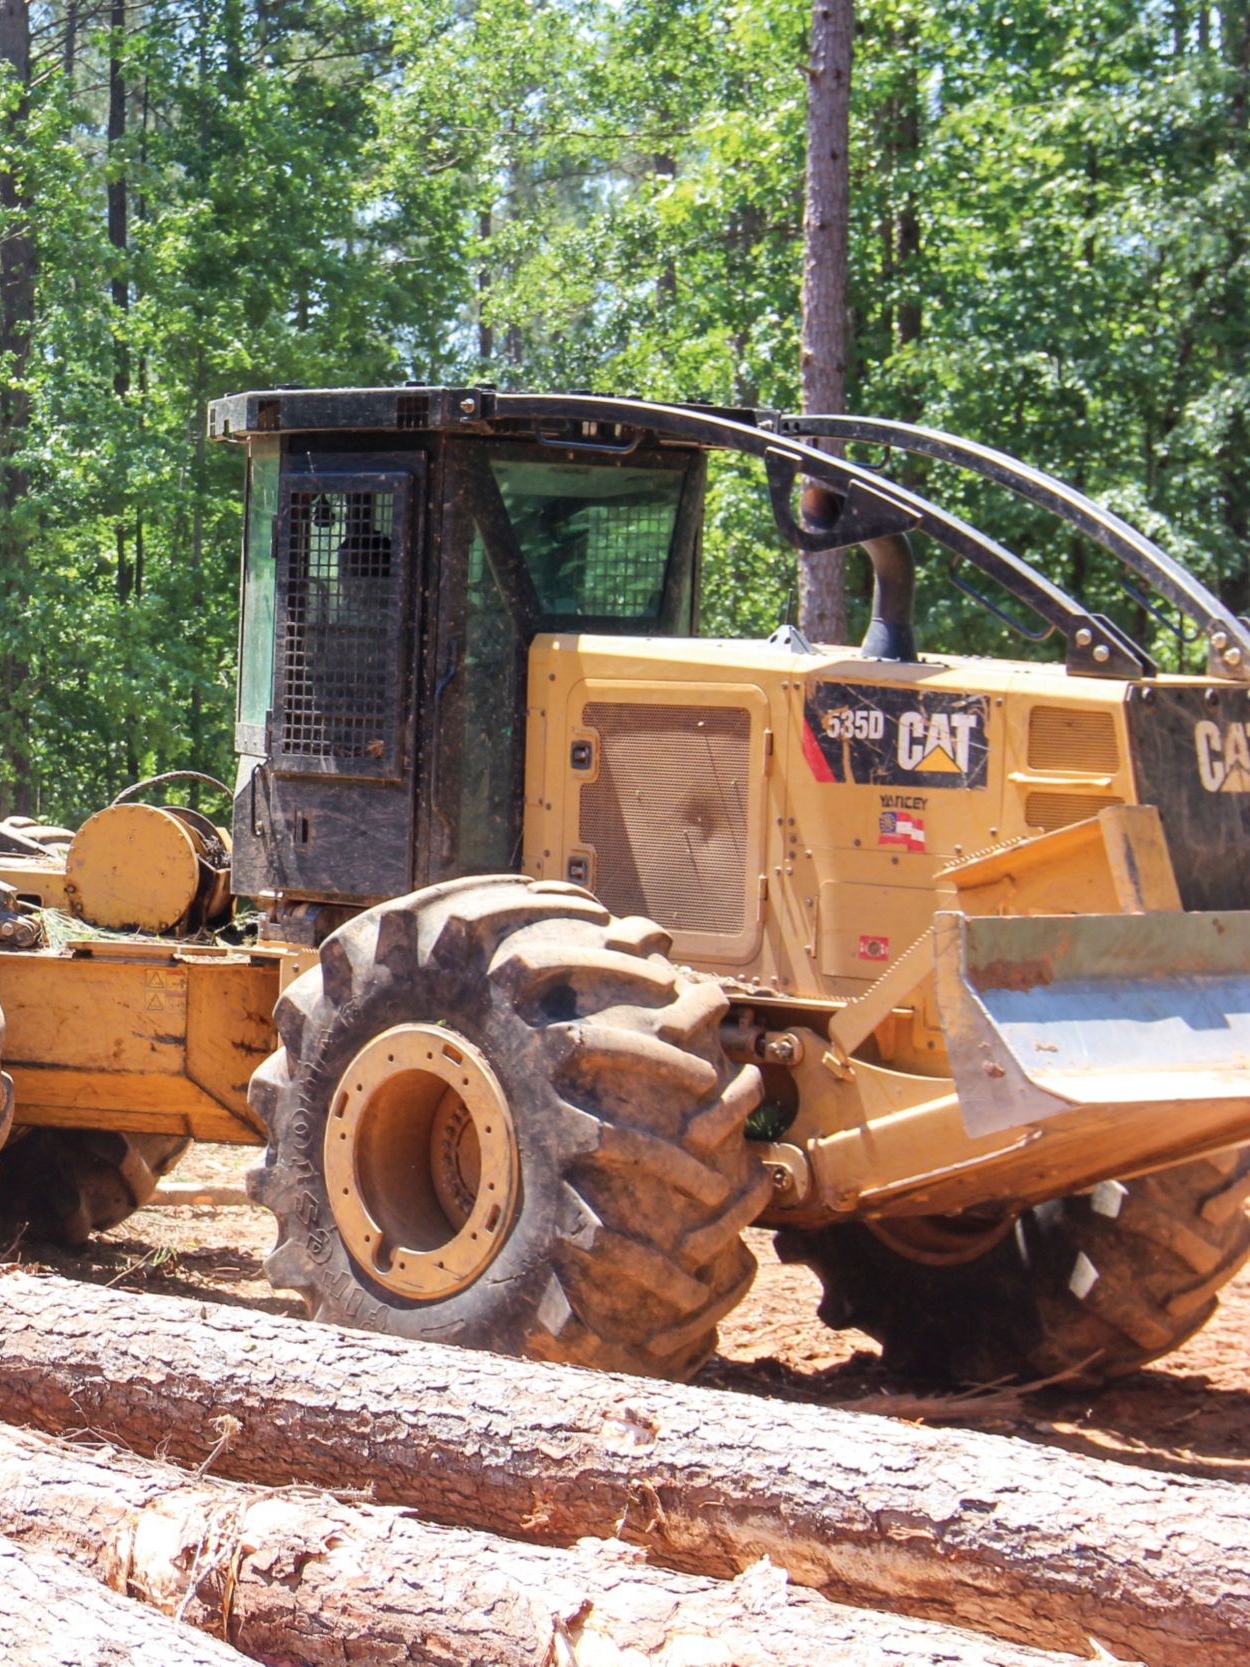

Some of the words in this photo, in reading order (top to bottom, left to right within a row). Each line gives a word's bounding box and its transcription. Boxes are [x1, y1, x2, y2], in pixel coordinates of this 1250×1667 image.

[827, 710, 884, 740] 535D
[898, 712, 977, 773] CAT
[1195, 720, 1250, 792] CA
[880, 795, 929, 810] YANCEY
